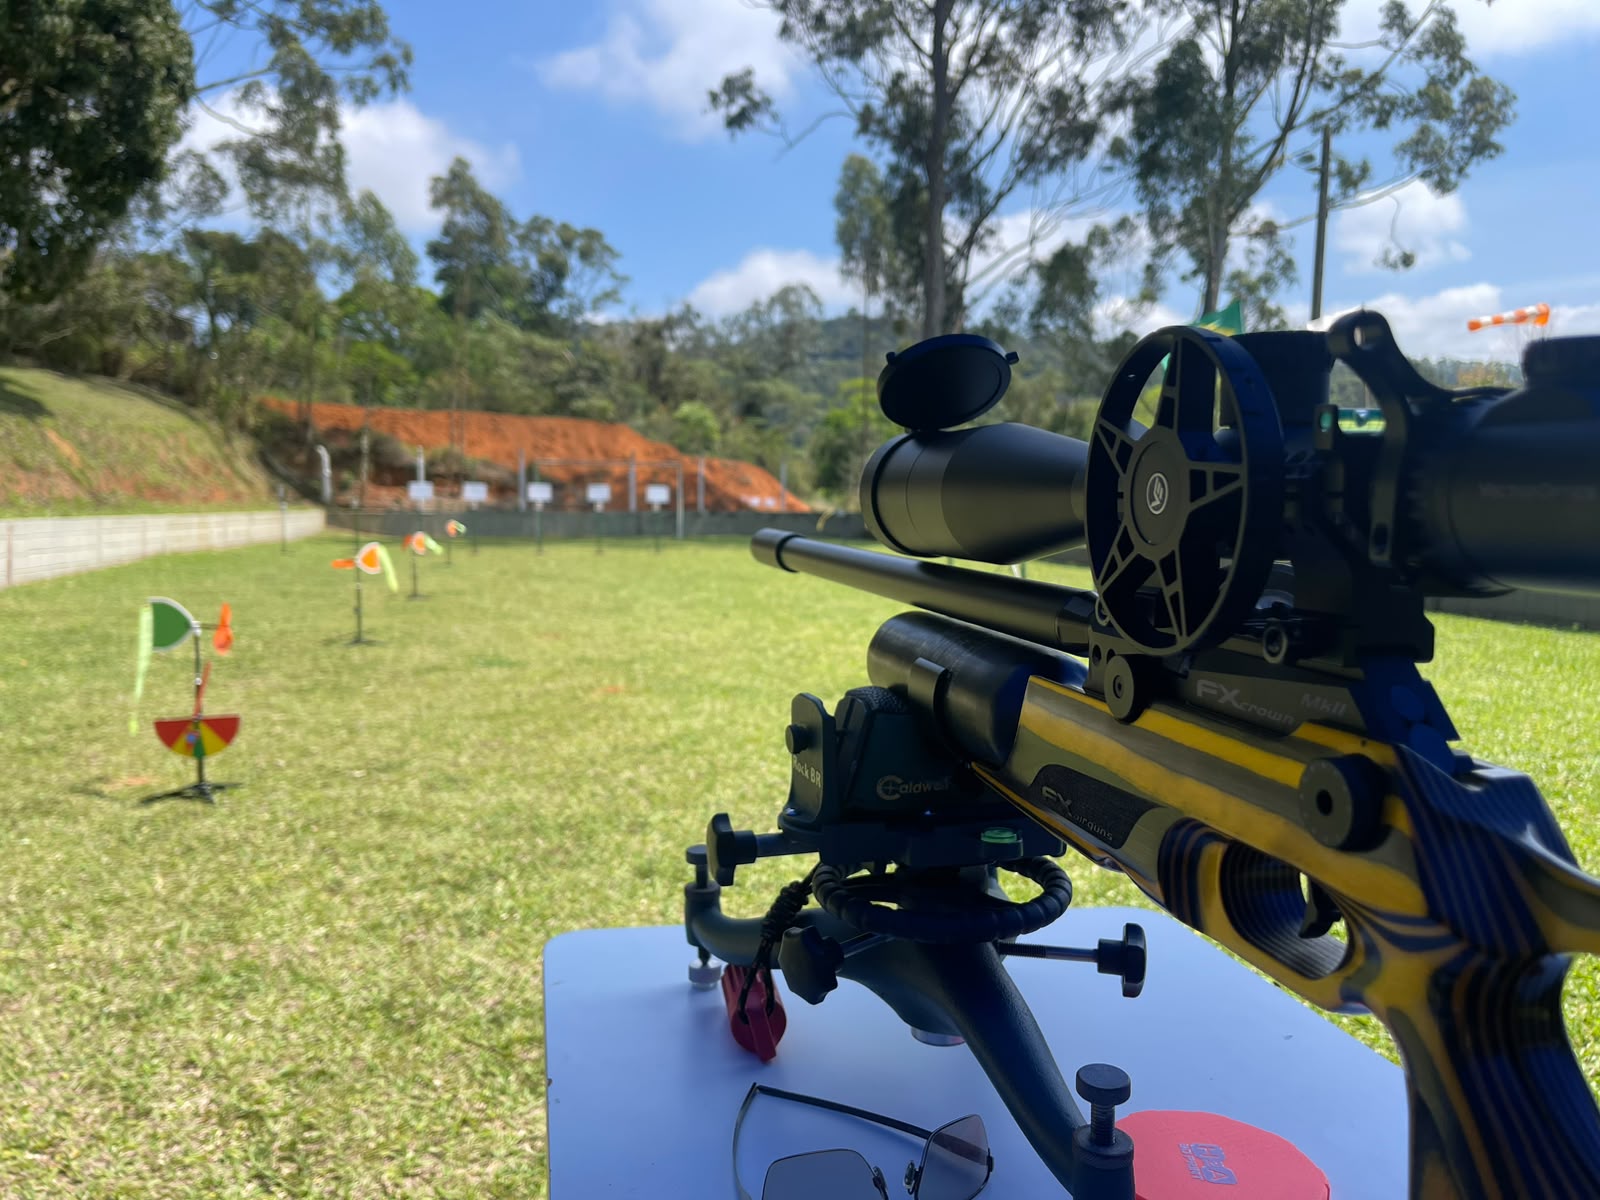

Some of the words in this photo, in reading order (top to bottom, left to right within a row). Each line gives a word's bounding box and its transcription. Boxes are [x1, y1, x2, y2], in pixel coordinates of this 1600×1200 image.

[1196, 679, 1242, 709] FX
[1240, 702, 1295, 726] crown
[810, 766, 822, 789] BR
[1041, 785, 1073, 818] FX
